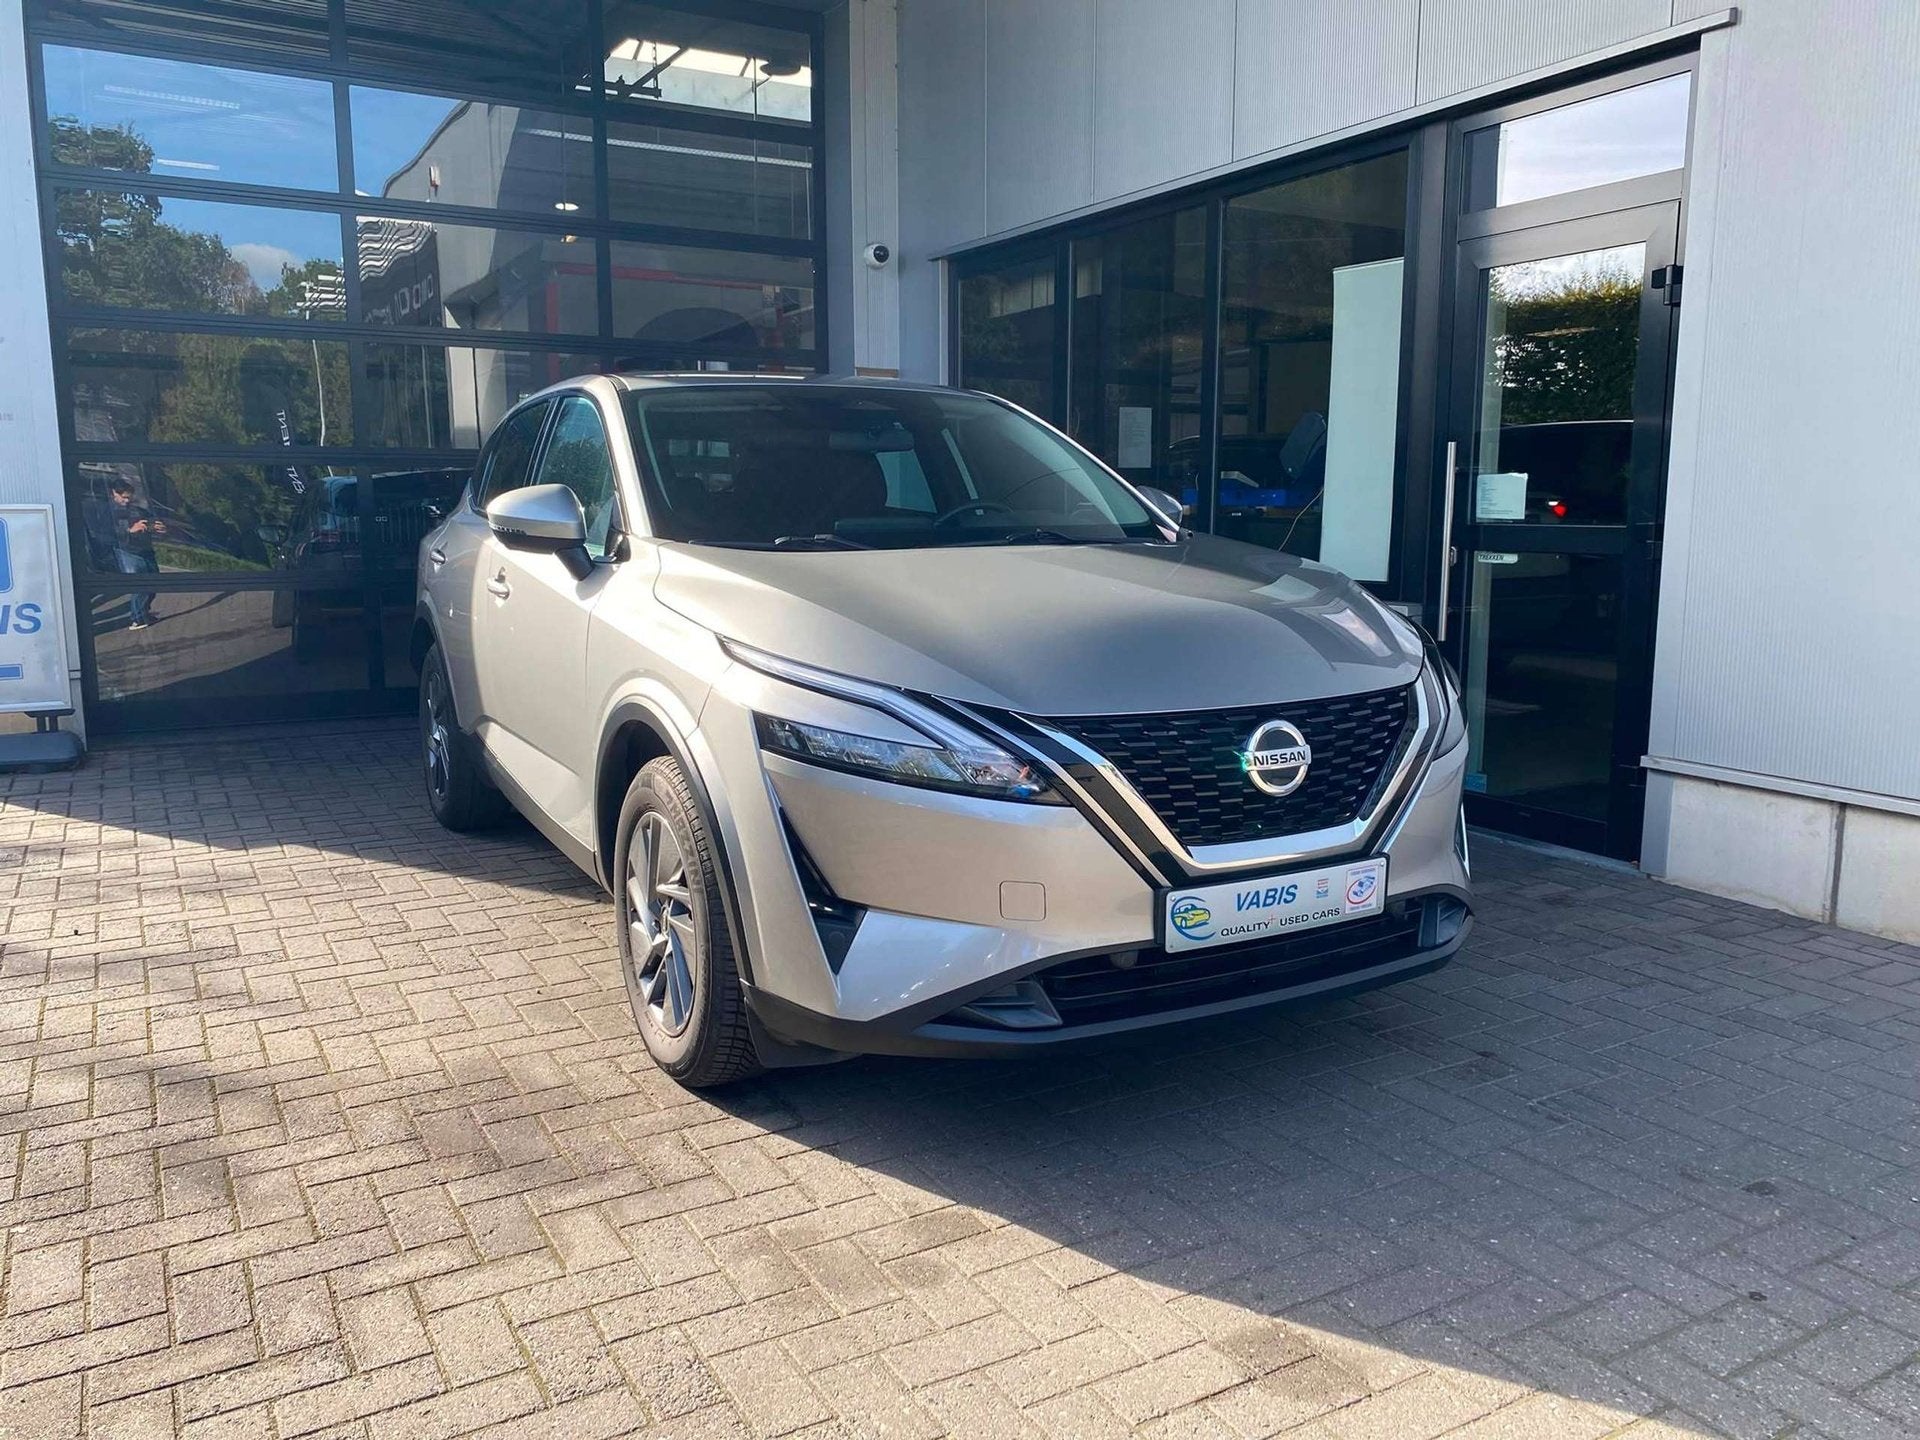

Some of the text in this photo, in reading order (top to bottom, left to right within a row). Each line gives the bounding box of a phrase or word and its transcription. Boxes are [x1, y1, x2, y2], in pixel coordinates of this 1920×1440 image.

[1253, 750, 1306, 766] NISSAN
[1236, 884, 1298, 912] VABIS
[1220, 907, 1340, 936] QUALITY USED CARS
